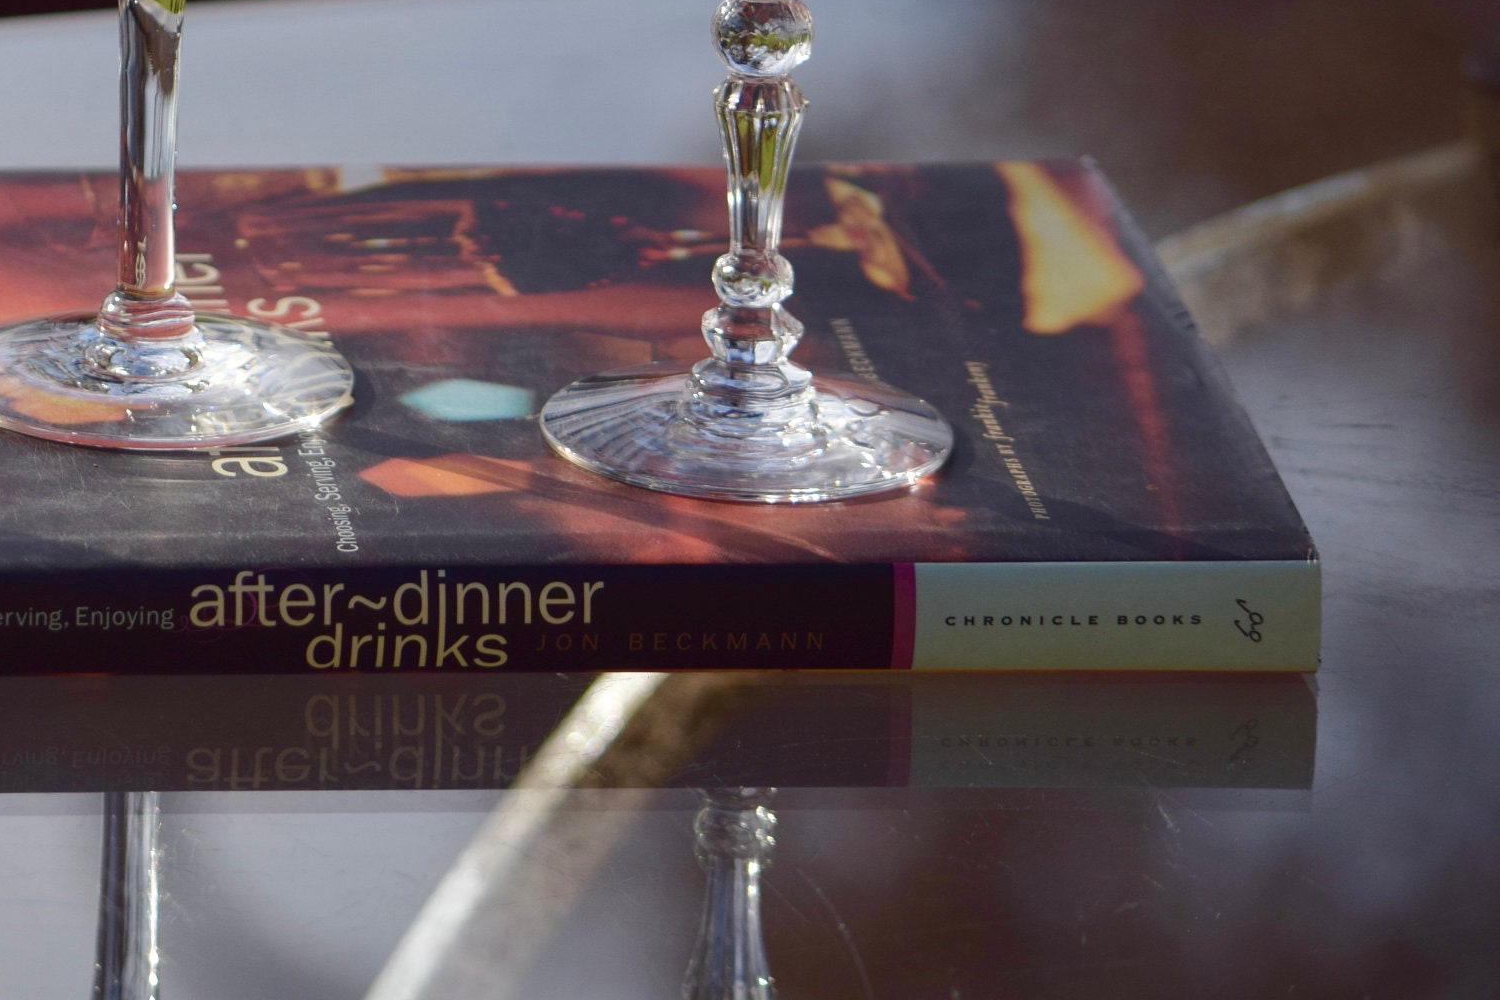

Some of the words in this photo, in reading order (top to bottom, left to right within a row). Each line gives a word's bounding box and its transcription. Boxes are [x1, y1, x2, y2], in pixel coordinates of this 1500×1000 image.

[995, 443, 1015, 455] BY
[305, 457, 341, 501] Serving,
[1002, 457, 1050, 520] PHOTOGRAPHS
[327, 503, 359, 553] Choosing,
[75, 606, 175, 630] Enjoying
[945, 615, 1099, 626] CHRONICLE
[1116, 614, 1202, 626] BOOKS
[306, 622, 508, 669] drinks
[536, 632, 599, 651] JON
[627, 631, 824, 650] BECKMANN
